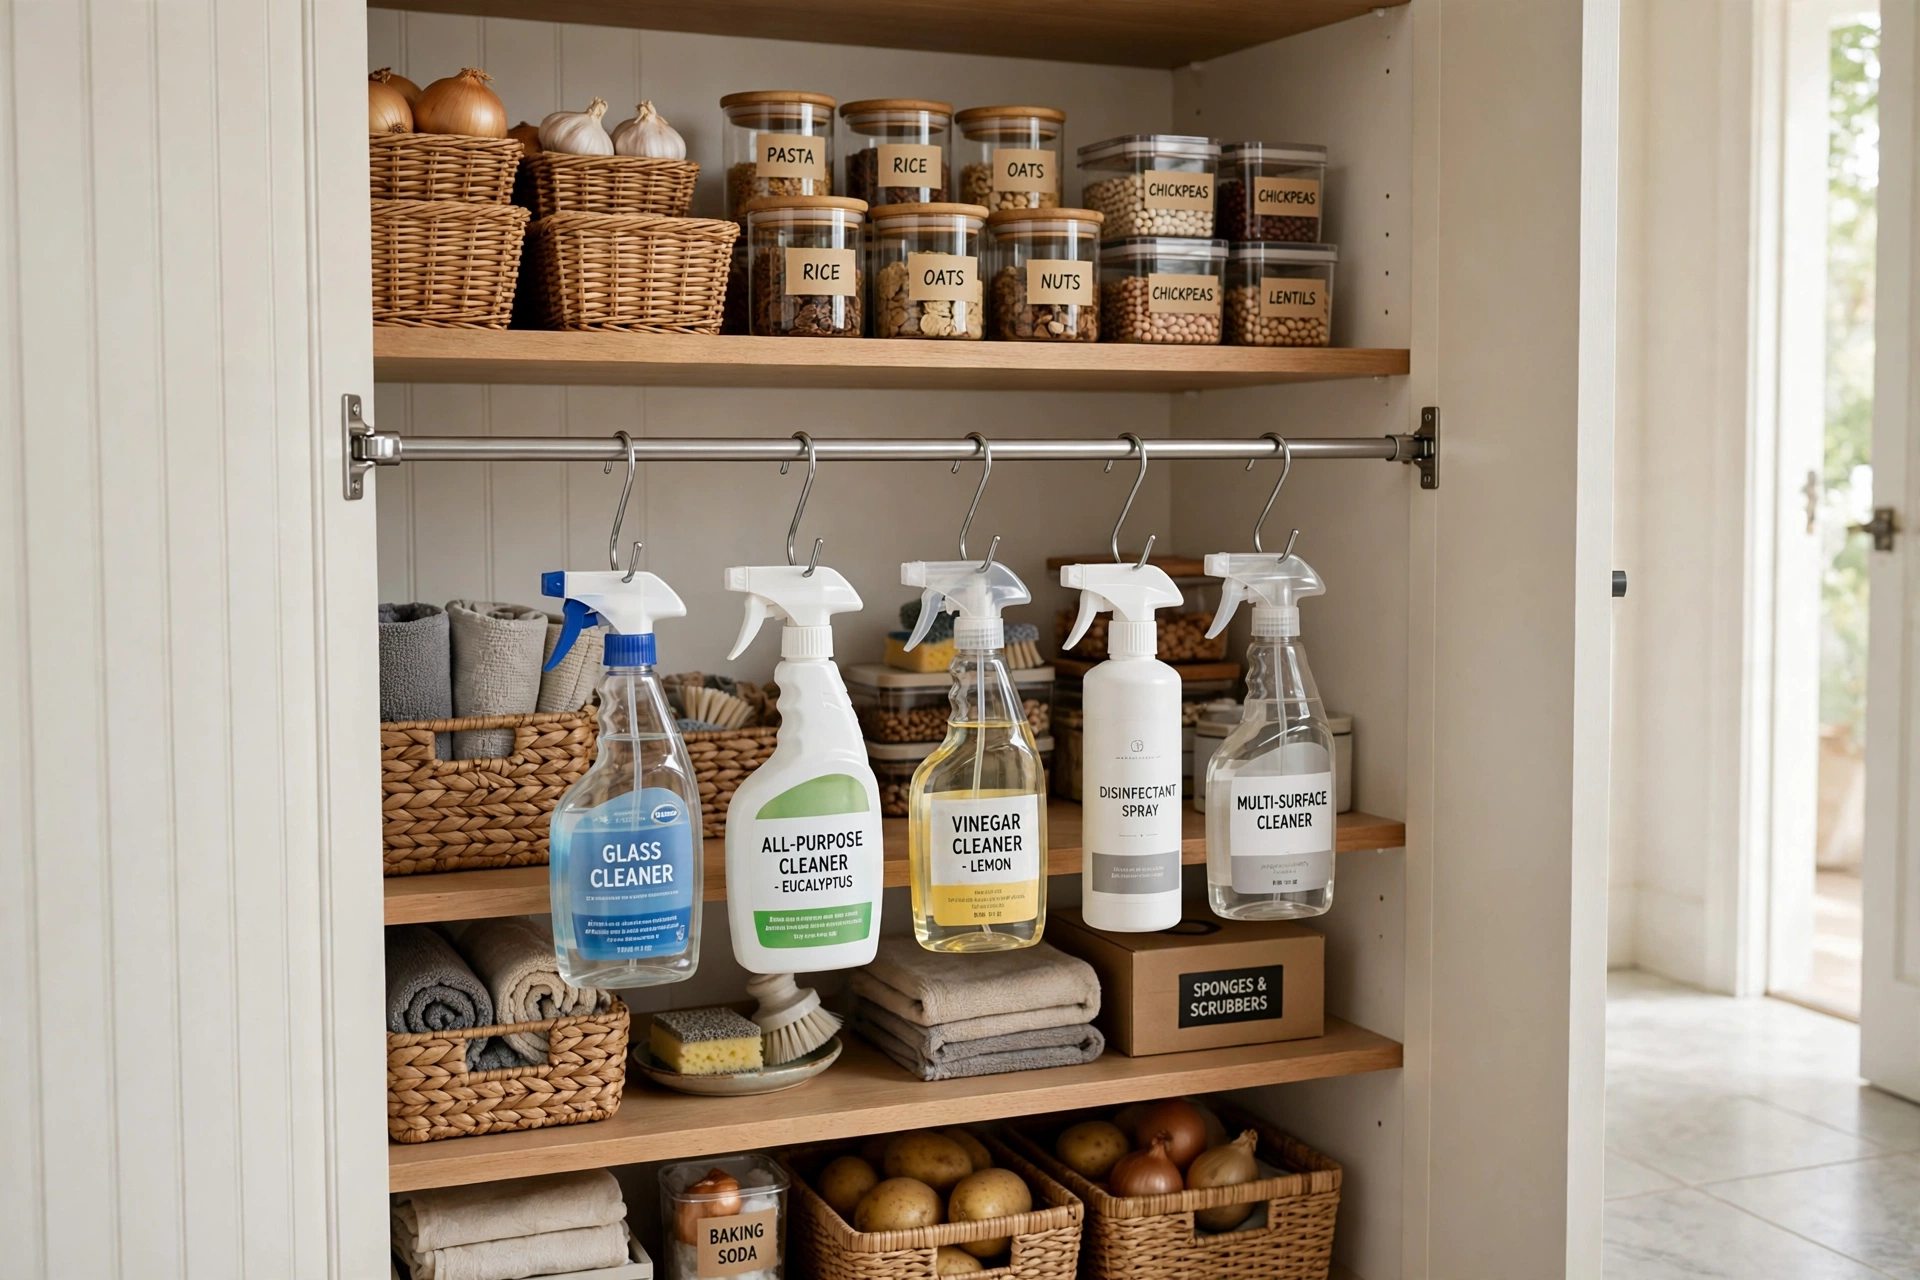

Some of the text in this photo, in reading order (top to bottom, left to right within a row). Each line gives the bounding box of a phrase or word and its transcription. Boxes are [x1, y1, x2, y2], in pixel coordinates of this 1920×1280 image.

[767, 147, 814, 165] PASTA
[893, 157, 927, 174] RICE
[1007, 162, 1044, 179] OATS
[1149, 183, 1209, 199] CHICKPEAS
[1258, 189, 1316, 205] CHICKPEAS
[803, 263, 840, 281] RICE
[923, 269, 964, 286] OATS
[1041, 273, 1081, 290] NUTS
[1152, 286, 1213, 301] CHICKPEAS
[1269, 291, 1316, 306] LENTILS
[1099, 783, 1177, 800] DISINFECTANT
[1237, 790, 1328, 811] MULTI-SURFACE
[1122, 804, 1159, 818] SPRAY
[951, 813, 1021, 833] VINEGAR
[1256, 812, 1313, 830] CLEANER
[761, 830, 863, 853] ALL-PURPOSE
[952, 835, 1023, 855] CLEANER
[602, 841, 662, 864] GLASS
[779, 853, 849, 875] CLEANER
[970, 857, 1012, 873] LEMON
[590, 864, 674, 888] CLEANER
[782, 875, 853, 893] EUCALYPTUS
[1193, 976, 1267, 998] SPONGES &
[1190, 995, 1268, 1017] SCRUBBERS
[710, 1223, 763, 1244] BAKING
[718, 1245, 757, 1264] SODA
